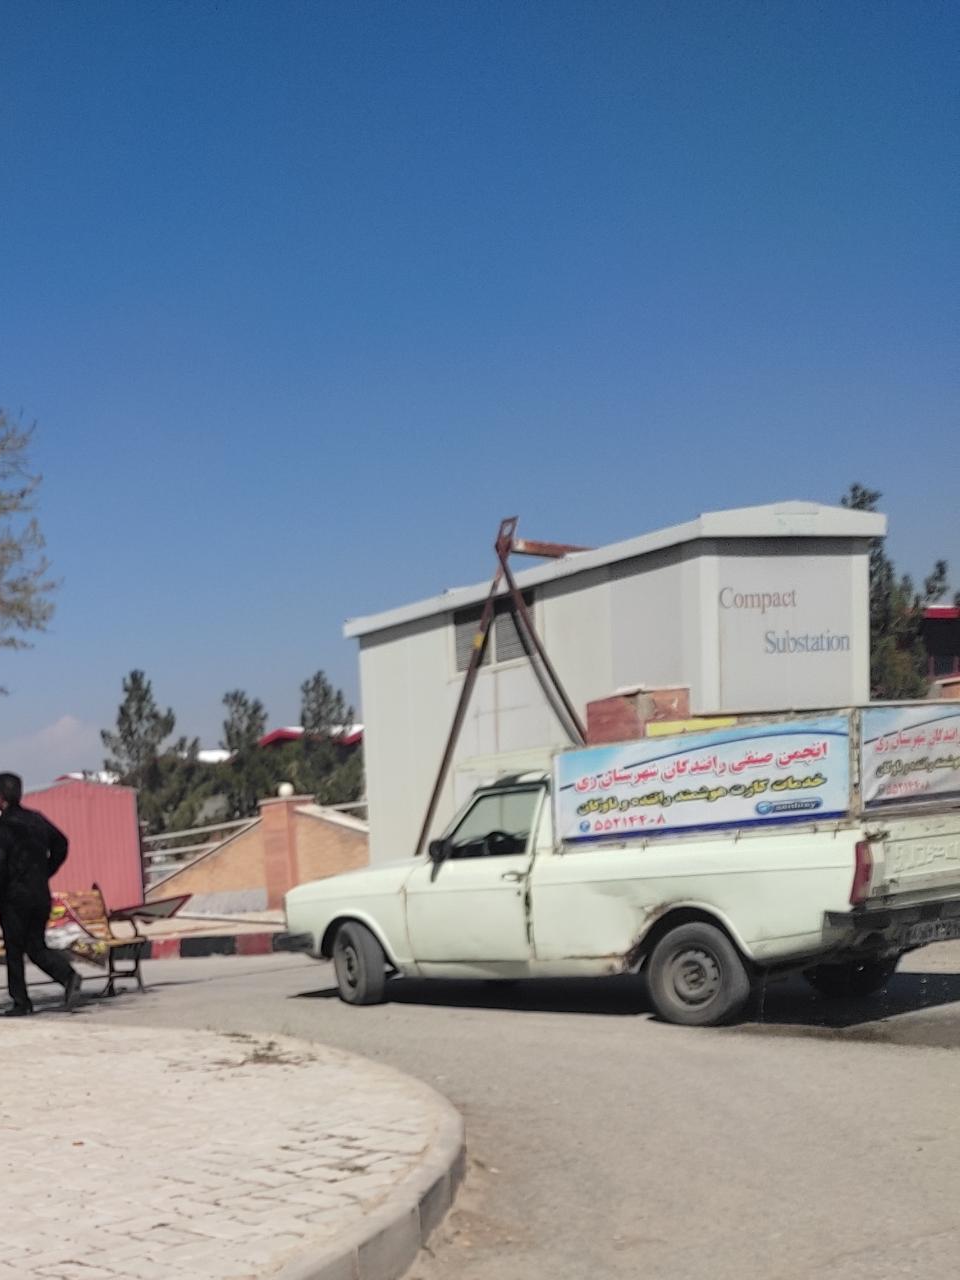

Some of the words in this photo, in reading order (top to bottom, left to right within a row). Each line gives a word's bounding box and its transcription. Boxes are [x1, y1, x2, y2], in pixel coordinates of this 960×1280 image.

[719, 587, 797, 614] Compact
[764, 629, 850, 654] Substation
[729, 751, 774, 774] صنفی
[777, 741, 828, 767] انجمن
[575, 776, 598, 792] ری
[599, 765, 659, 789] شهرستان
[771, 772, 828, 791] خدمات
[673, 784, 728, 802] هوشمند
[728, 778, 770, 798] کارت
[577, 795, 619, 816] ناوگان
[619, 799, 631, 812] و
